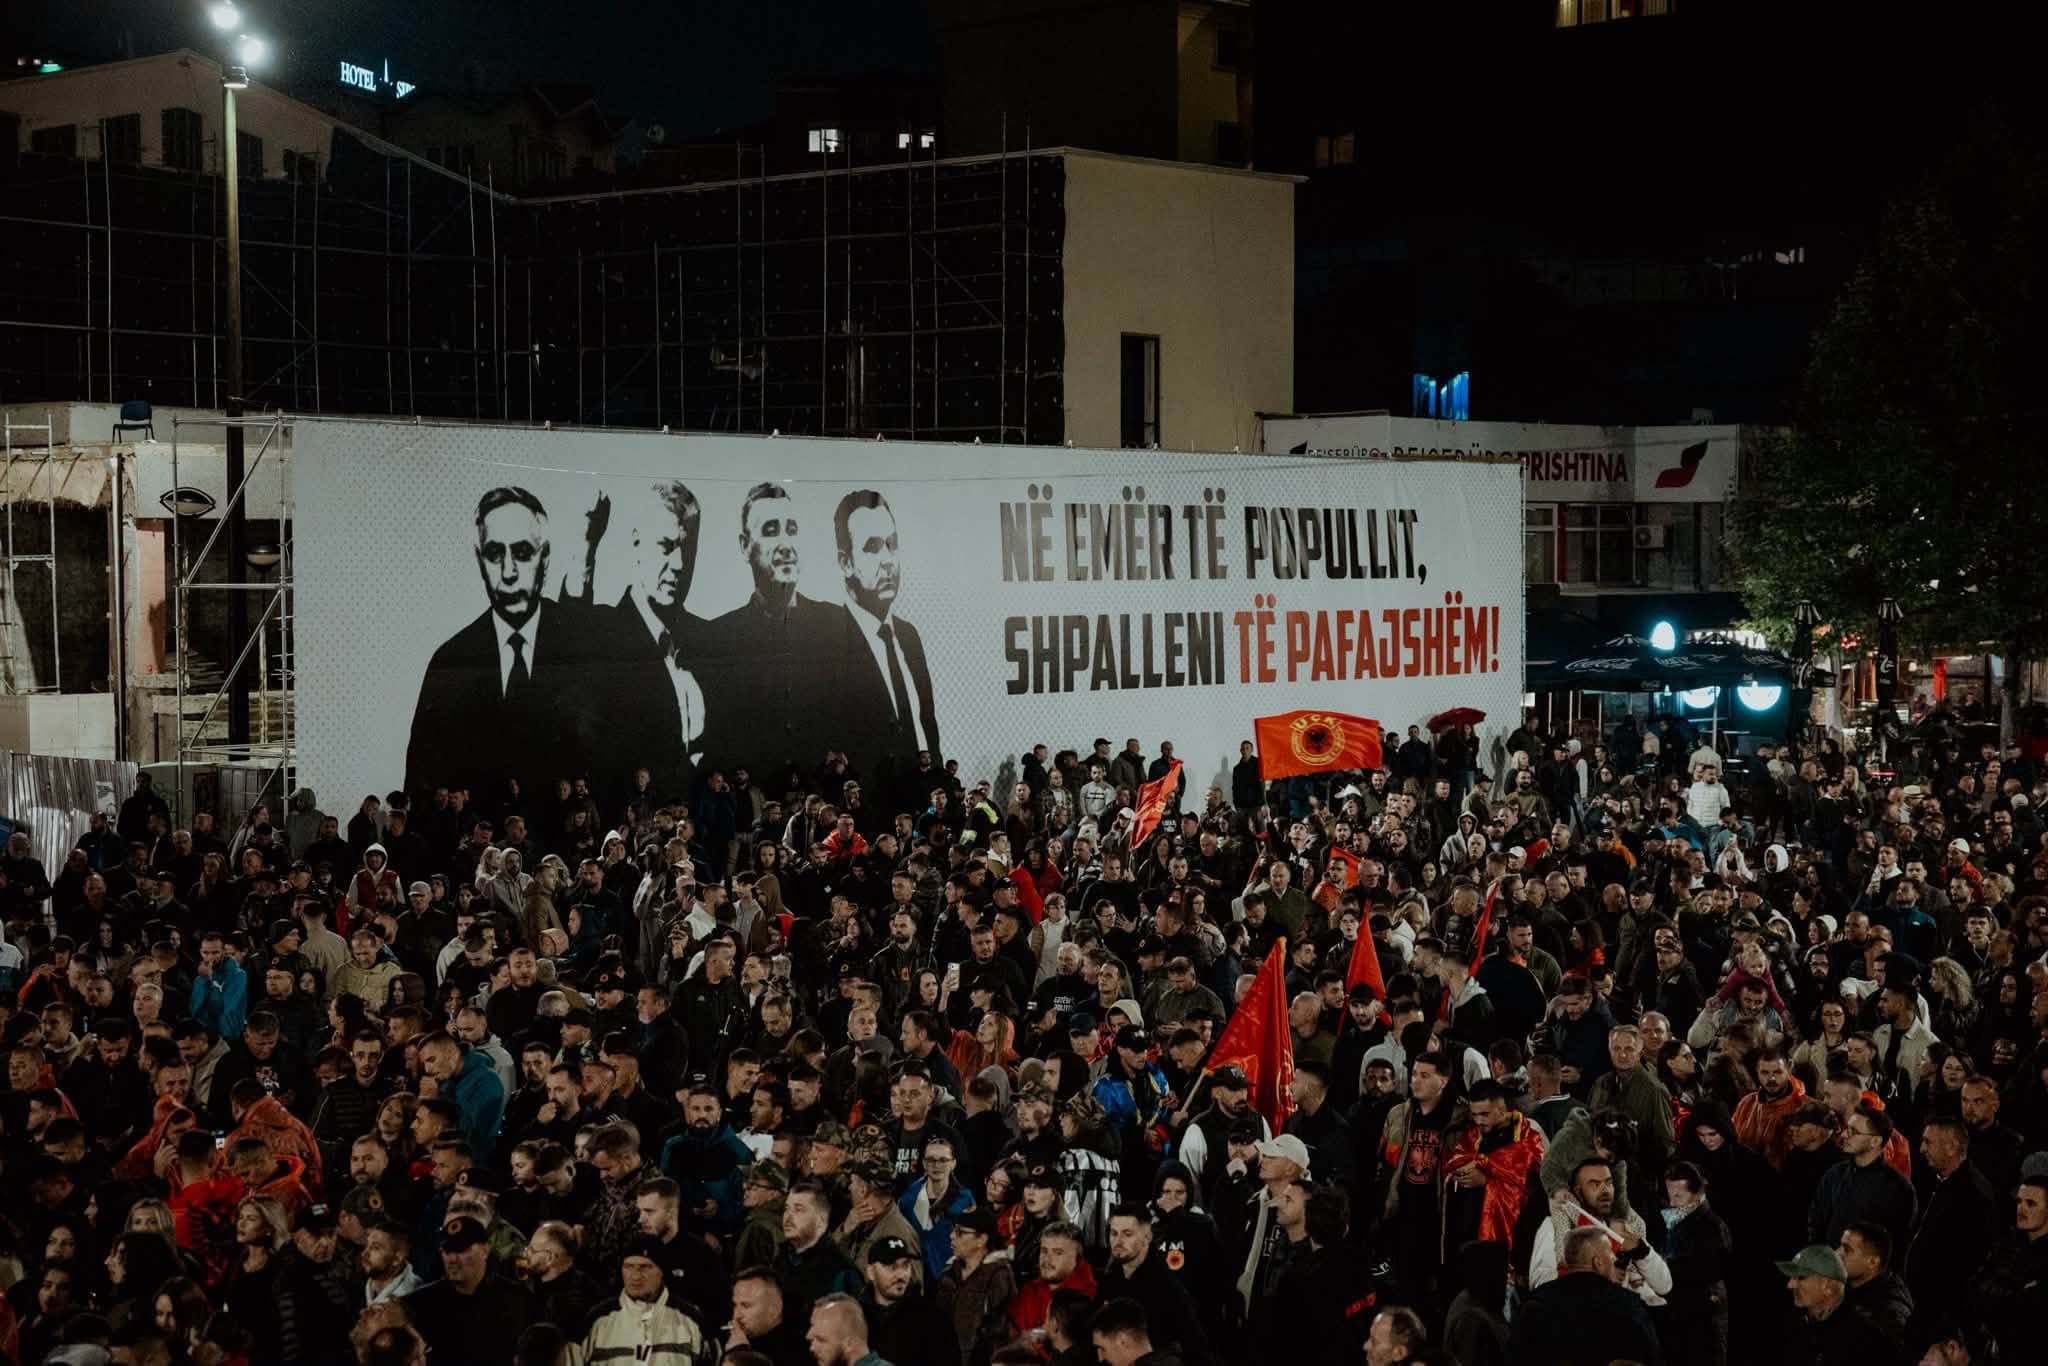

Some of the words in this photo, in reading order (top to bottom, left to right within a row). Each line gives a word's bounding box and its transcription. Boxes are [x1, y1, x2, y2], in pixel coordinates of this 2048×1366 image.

[340, 61, 376, 92] HOTEL
[999, 483, 1055, 581] NË
[1064, 485, 1175, 580] EMËR
[1183, 487, 1228, 580] TË
[1244, 506, 1427, 584] POPULLIT,
[1004, 611, 1225, 695] SHPALLENI
[1233, 593, 1277, 684] TË
[1286, 590, 1499, 682] PAFAJSHËM!
